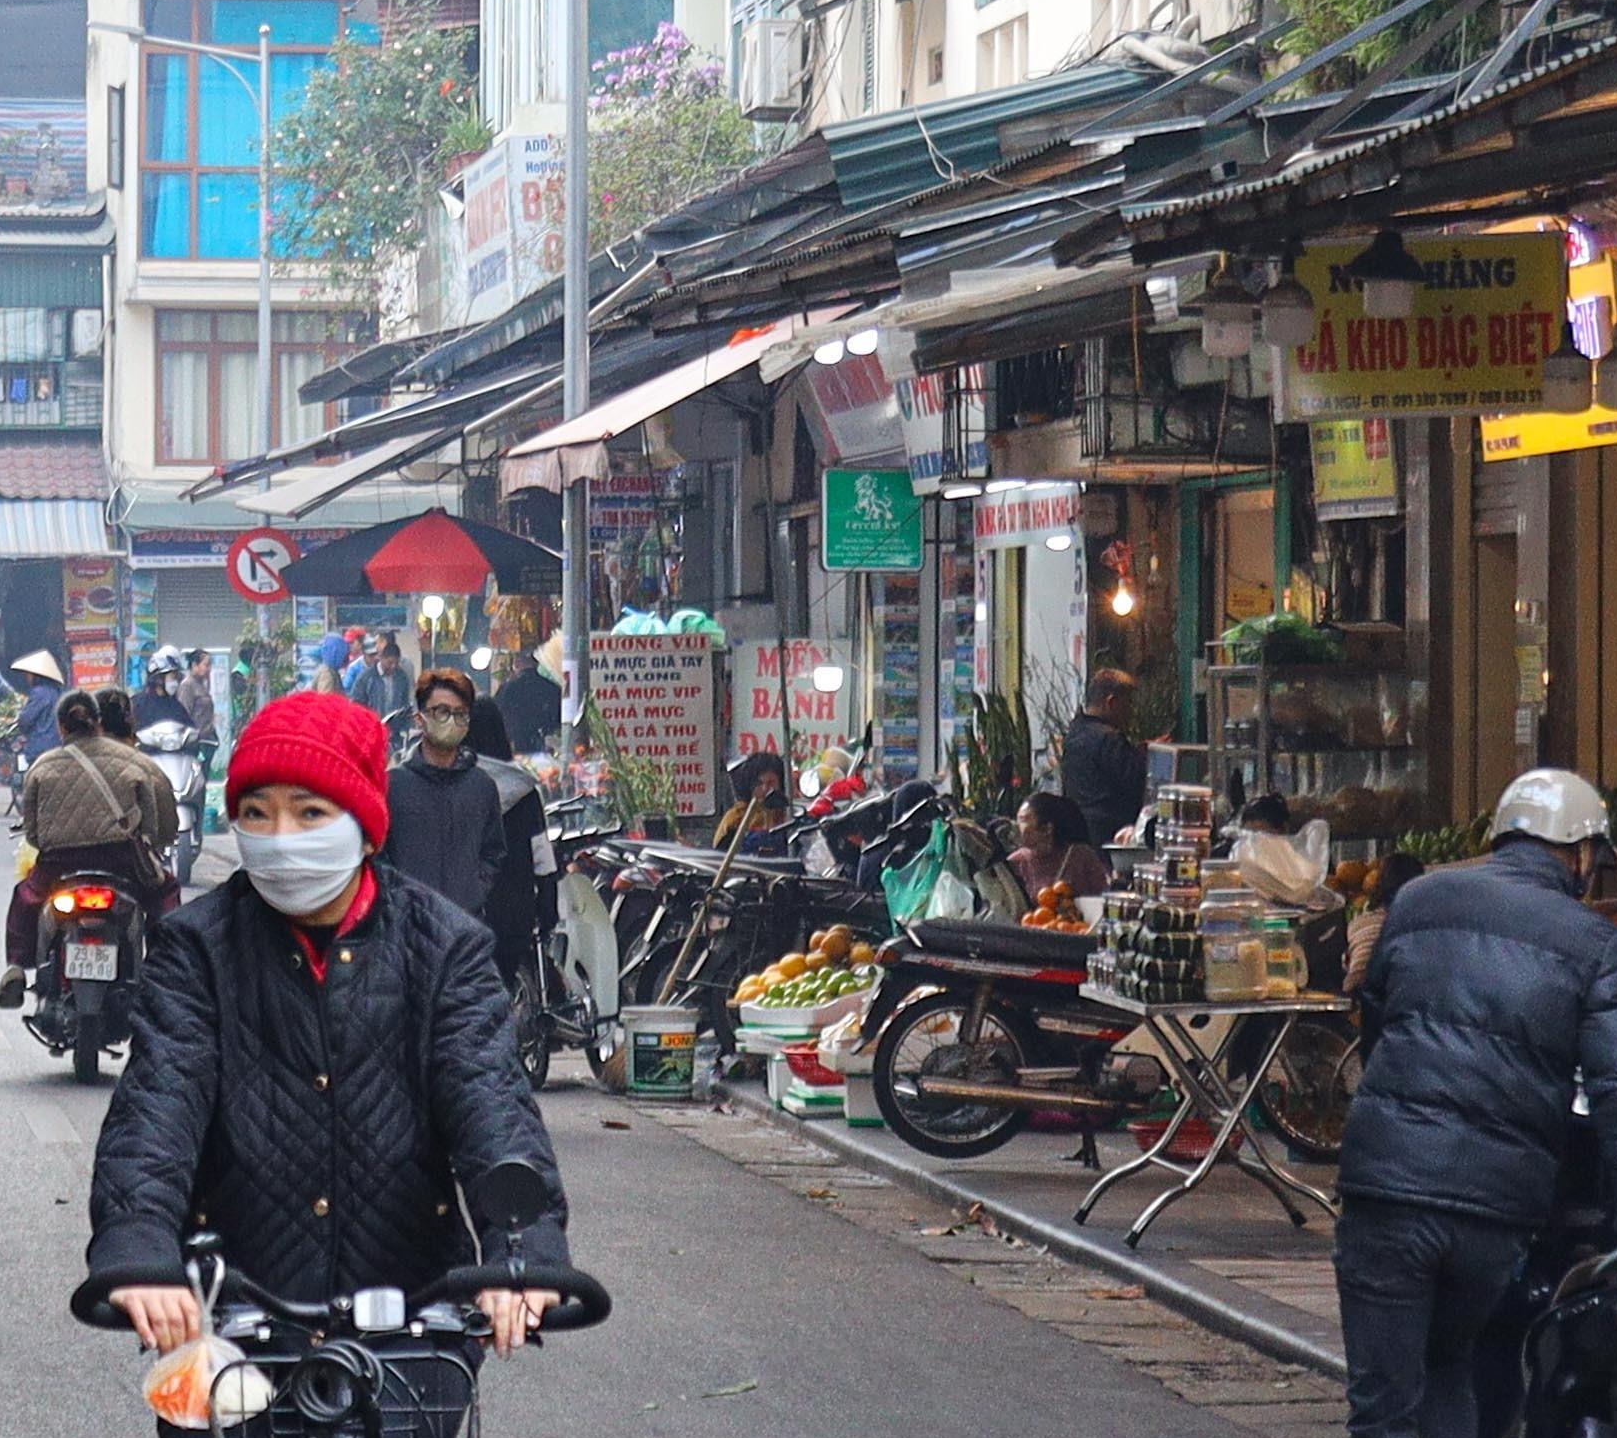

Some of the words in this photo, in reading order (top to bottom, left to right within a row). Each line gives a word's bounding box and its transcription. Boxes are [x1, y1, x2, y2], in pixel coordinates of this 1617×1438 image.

[1346, 316, 1409, 372] KHO
[1417, 304, 1479, 381] ĐẶC
[1487, 300, 1555, 379] BIỆT
[671, 634, 709, 650] VUI
[680, 655, 704, 668] TAY
[626, 672, 682, 682] LONG
[626, 686, 669, 701] MỰC
[673, 686, 702, 698] VIP
[643, 704, 685, 719] MỰC
[665, 723, 697, 737] THU
[634, 744, 673, 757] CUA
